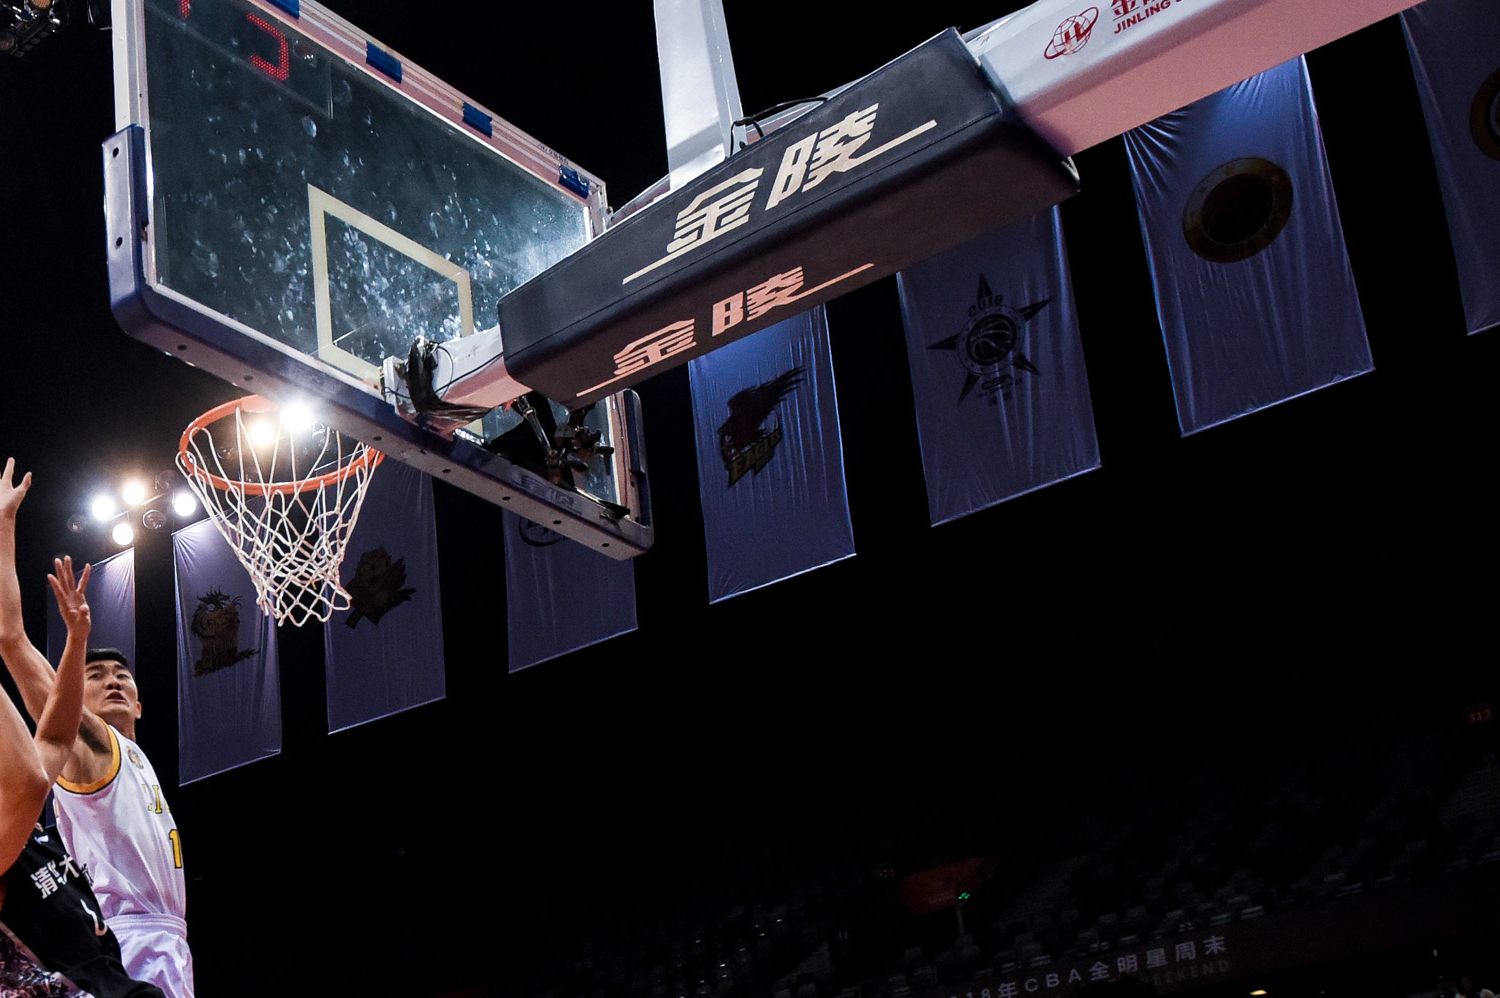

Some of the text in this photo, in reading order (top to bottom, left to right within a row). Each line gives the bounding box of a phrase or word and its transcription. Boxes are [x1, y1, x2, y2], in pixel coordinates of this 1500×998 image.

[1114, 0, 1171, 35] JINLING
[650, 103, 912, 268] 金陵
[594, 264, 840, 388] 金陵
